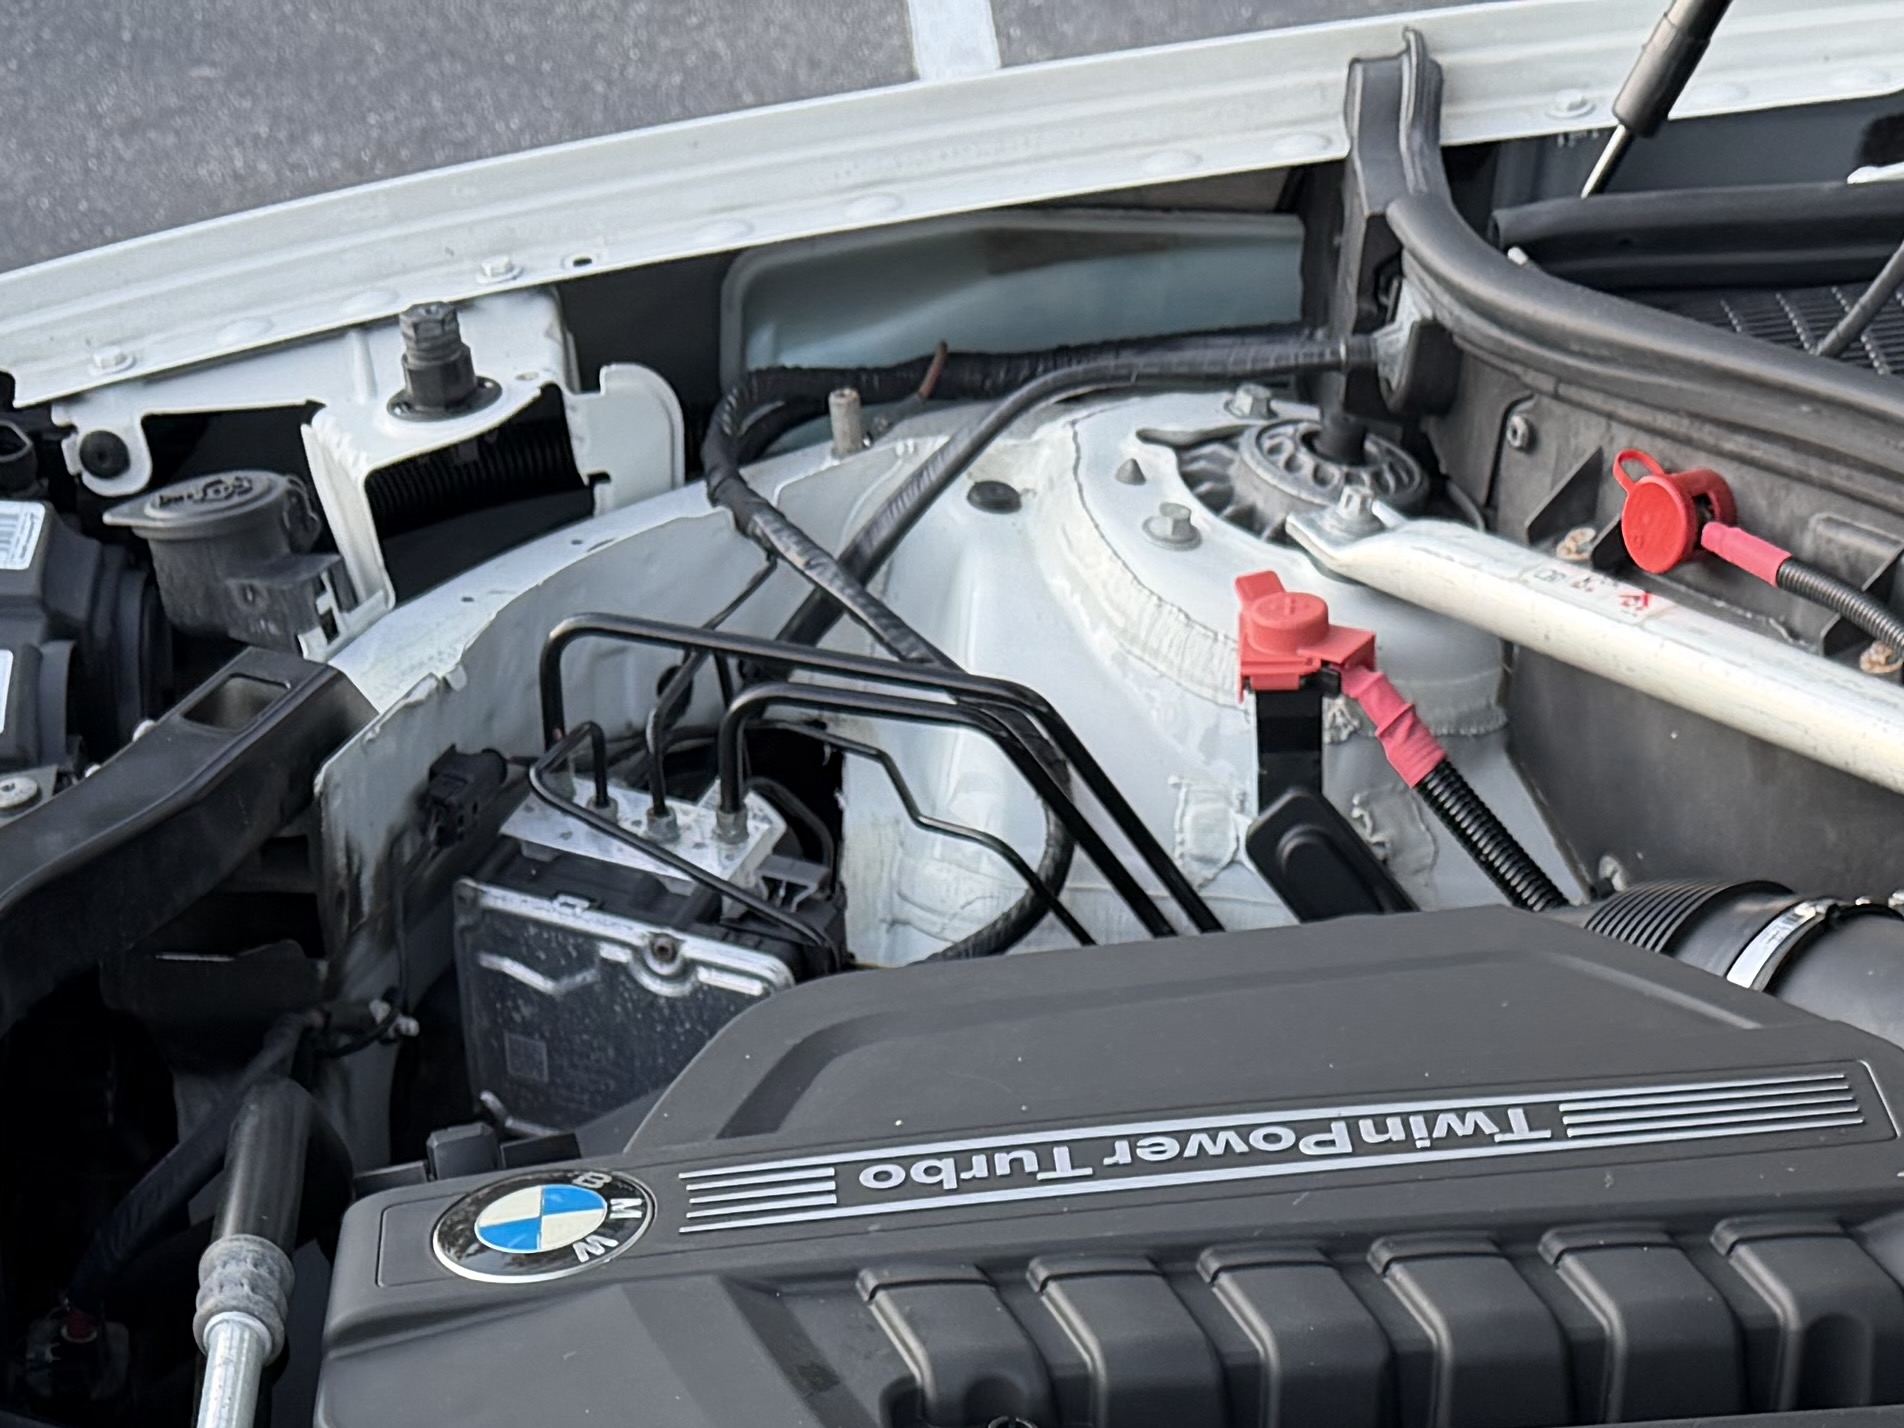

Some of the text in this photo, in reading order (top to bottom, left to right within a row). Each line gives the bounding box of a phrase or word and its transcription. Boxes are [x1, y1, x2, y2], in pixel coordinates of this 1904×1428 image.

[859, 1105, 1552, 1190] TwinPower Turbo
[572, 1171, 643, 1263] BMW
